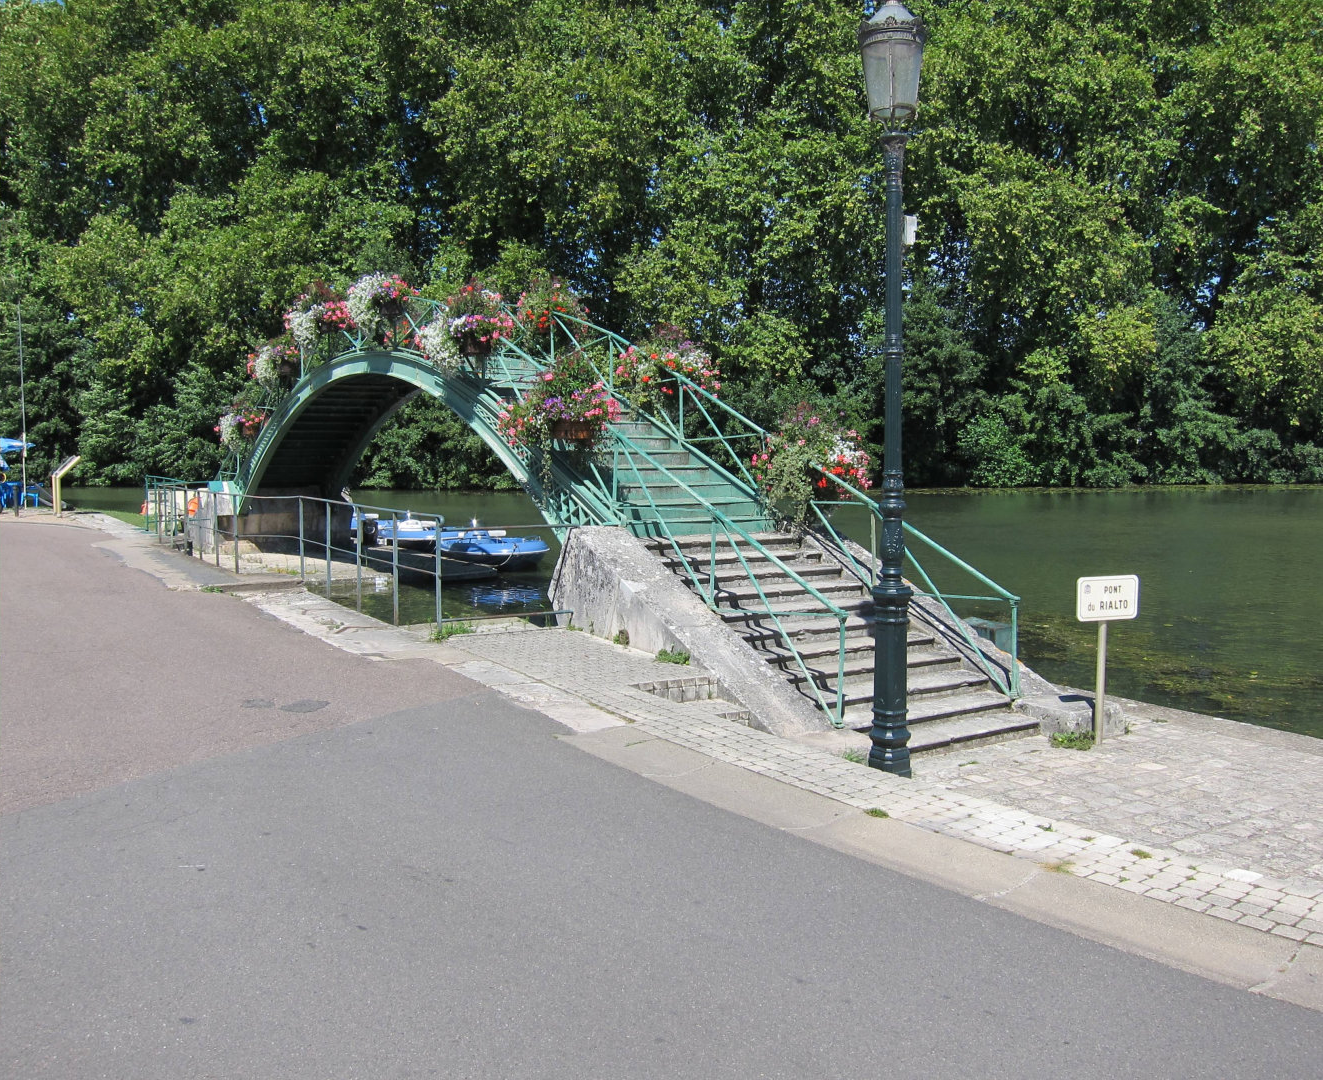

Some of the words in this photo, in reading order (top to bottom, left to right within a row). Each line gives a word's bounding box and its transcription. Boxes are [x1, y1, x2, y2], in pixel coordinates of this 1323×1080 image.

[1104, 586, 1121, 594] PONT
[1088, 602, 1095, 611] du
[1100, 600, 1128, 610] RIALTO
